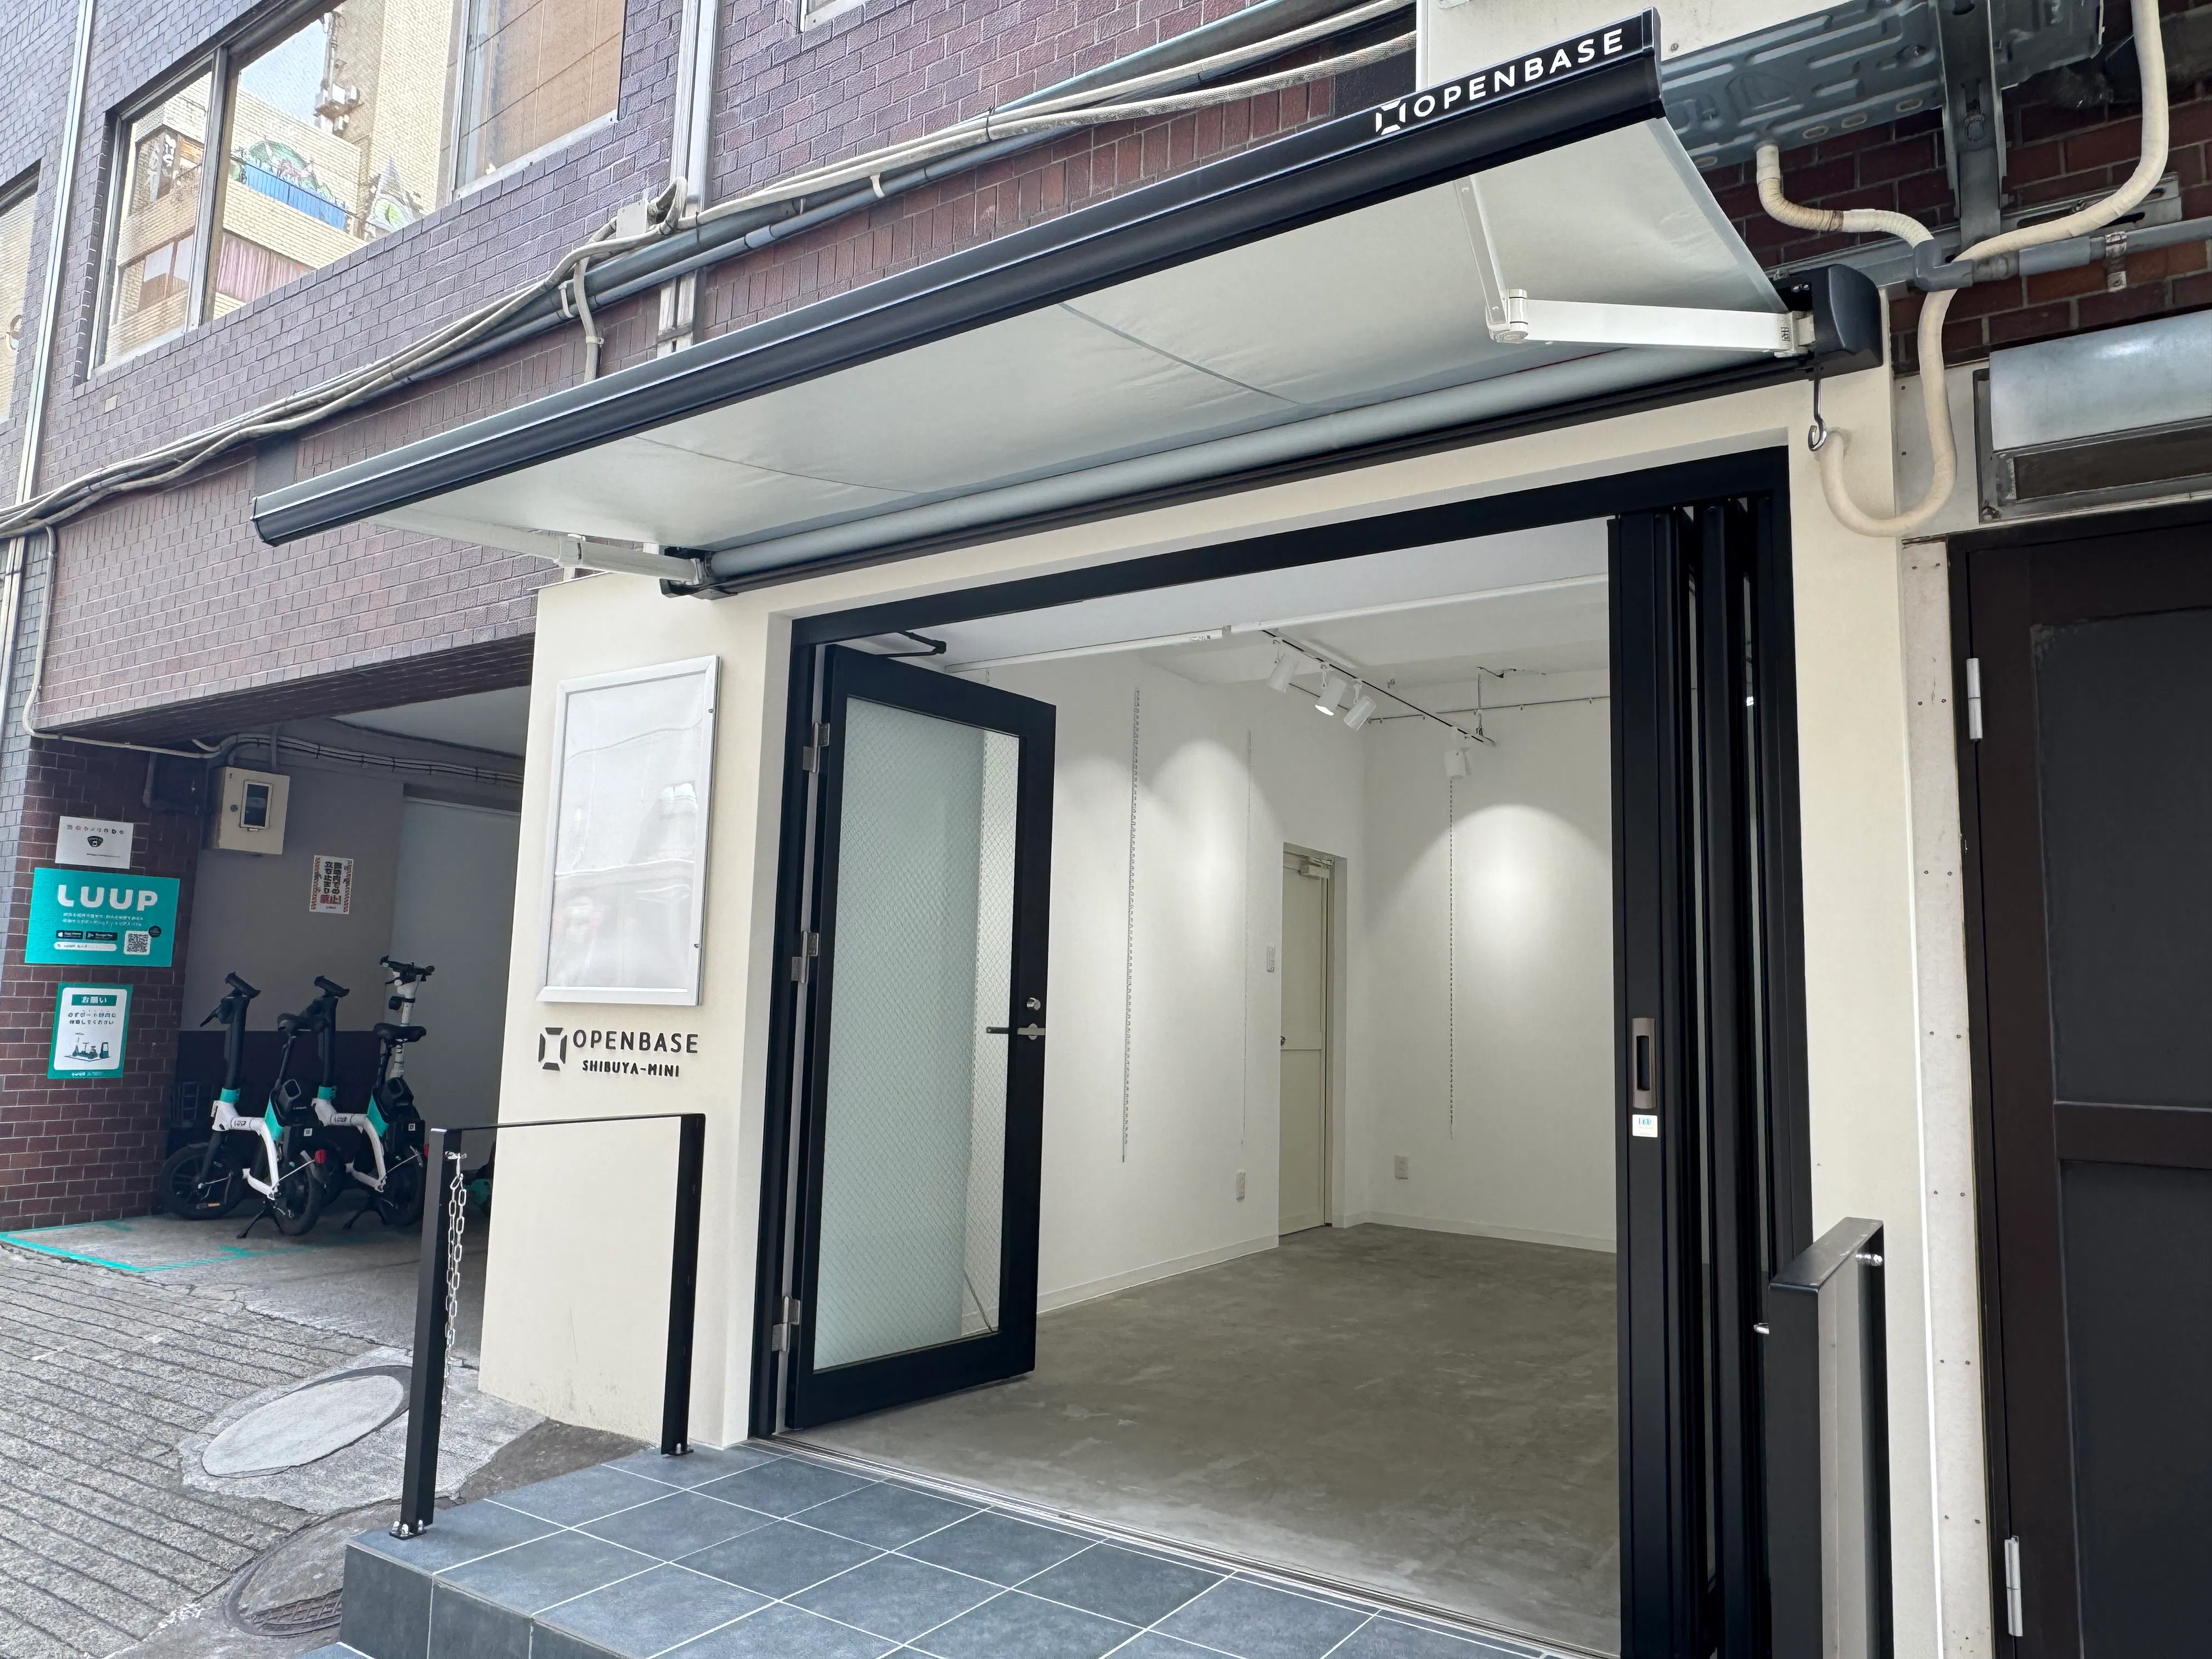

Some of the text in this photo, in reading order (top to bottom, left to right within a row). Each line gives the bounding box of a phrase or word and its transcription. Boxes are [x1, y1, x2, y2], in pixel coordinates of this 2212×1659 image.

[1413, 28, 1623, 118] OPENBASE
[58, 884, 158, 911] LUUP
[573, 1029, 698, 1053] OPENBASE
[582, 1060, 679, 1077] SHIBUYA-MINI
